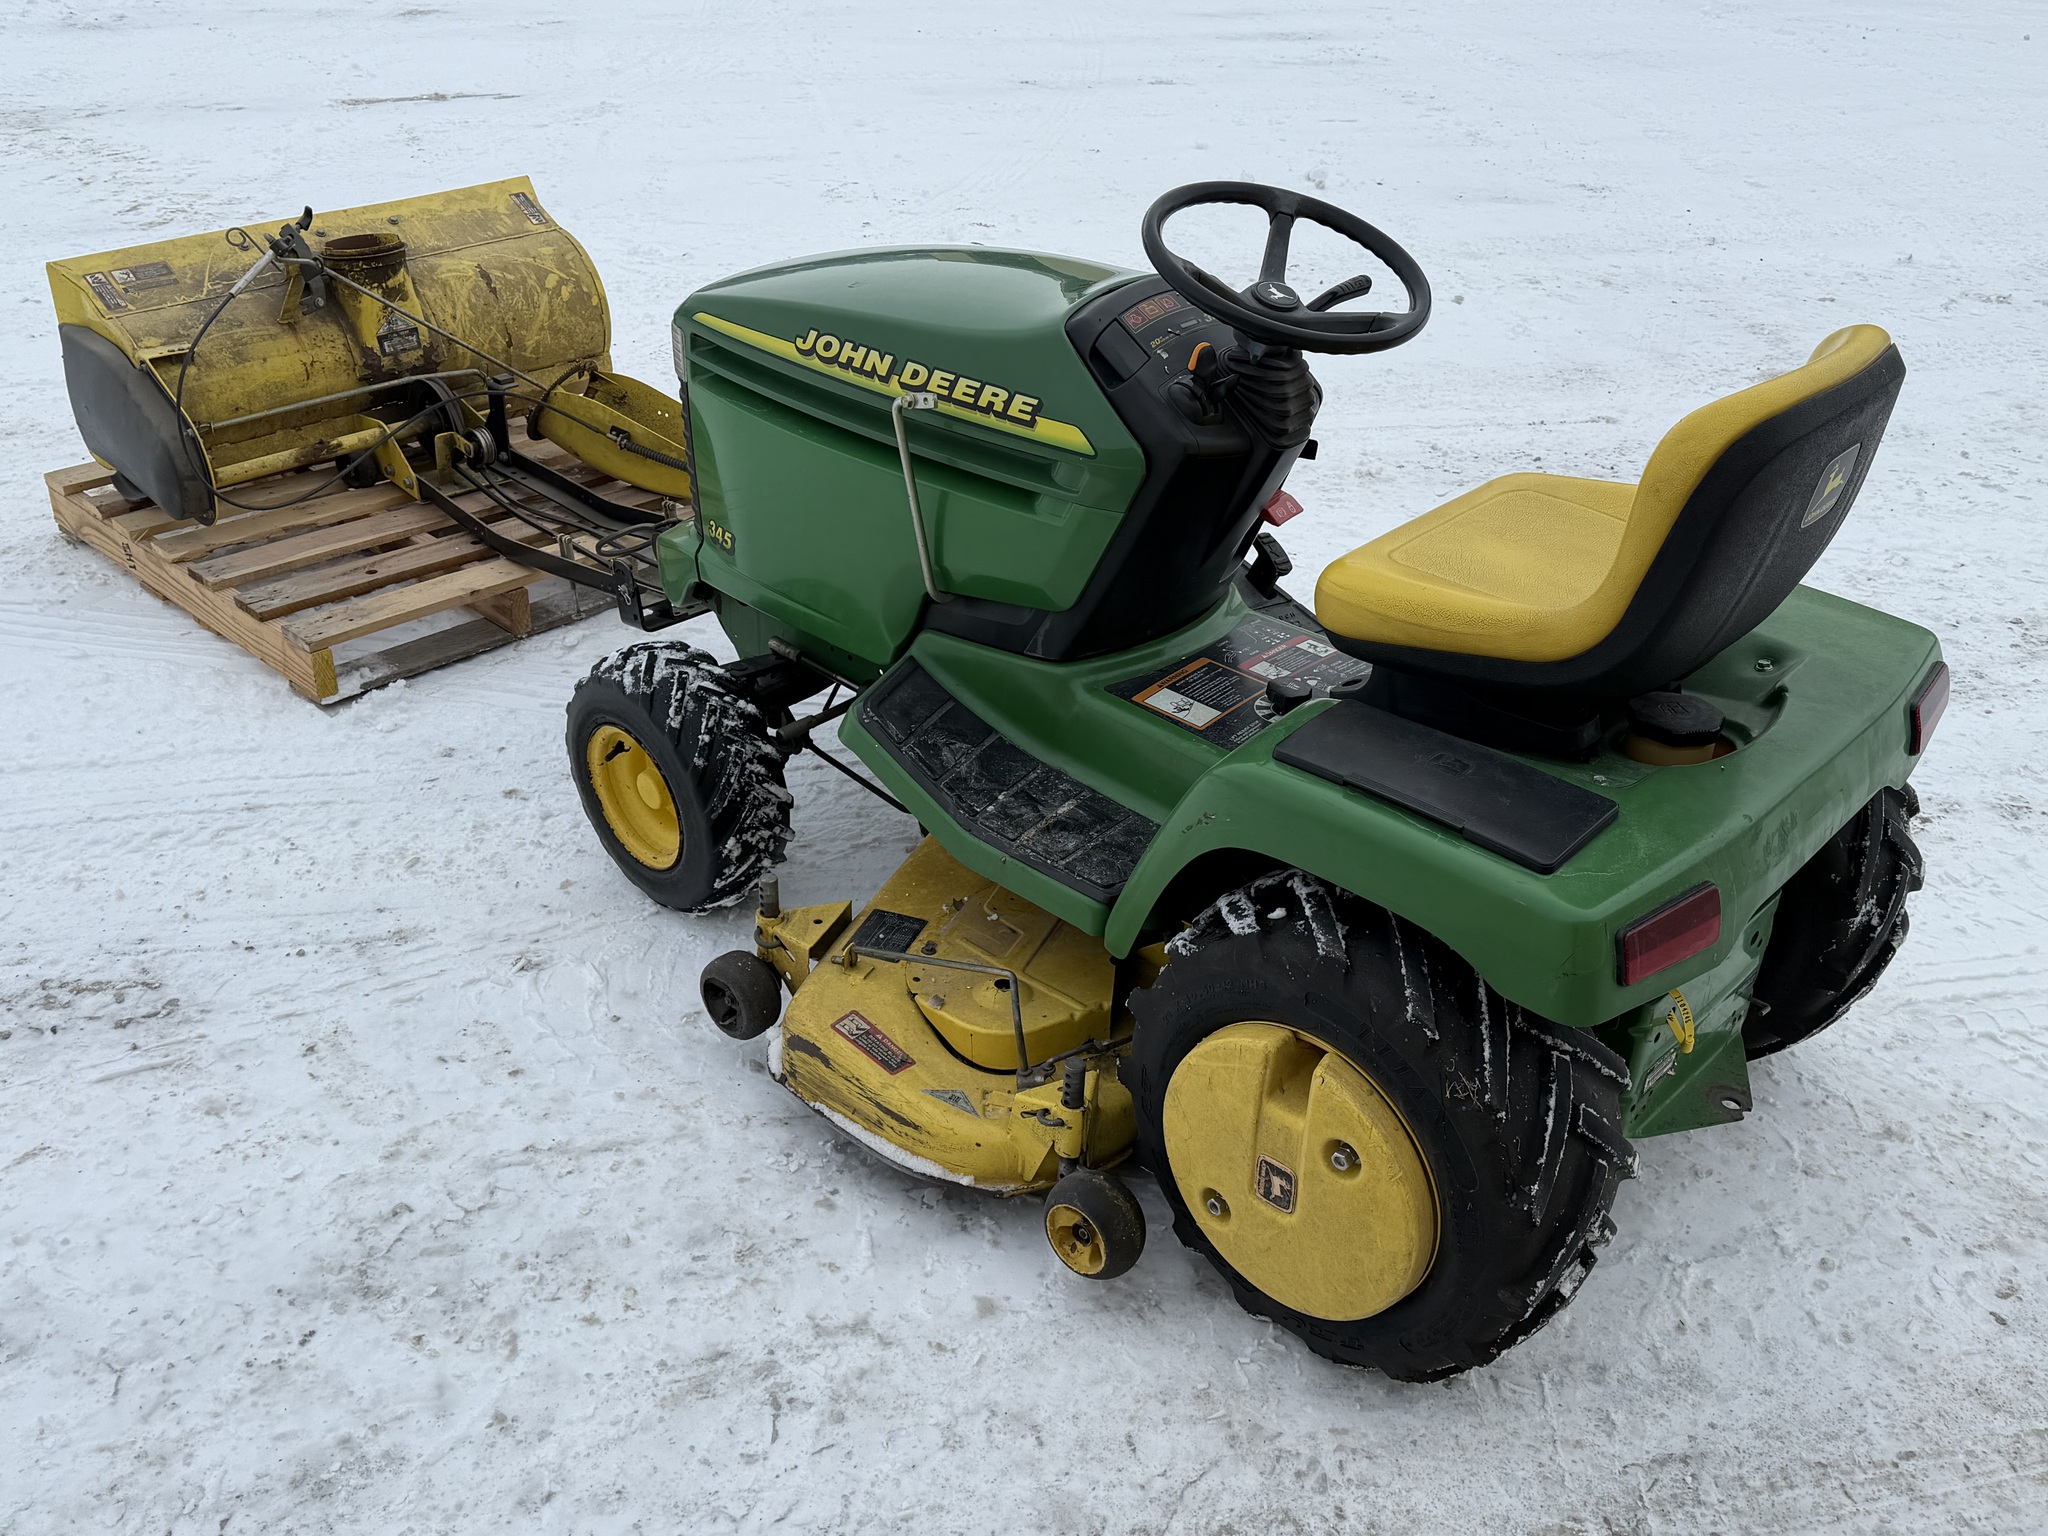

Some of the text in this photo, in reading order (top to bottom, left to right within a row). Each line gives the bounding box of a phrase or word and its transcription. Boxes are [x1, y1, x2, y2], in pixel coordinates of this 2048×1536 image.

[795, 328, 1041, 425] JOHN DEERE
[709, 520, 733, 550] 345
[1355, 1022, 1446, 1128] TITAN
